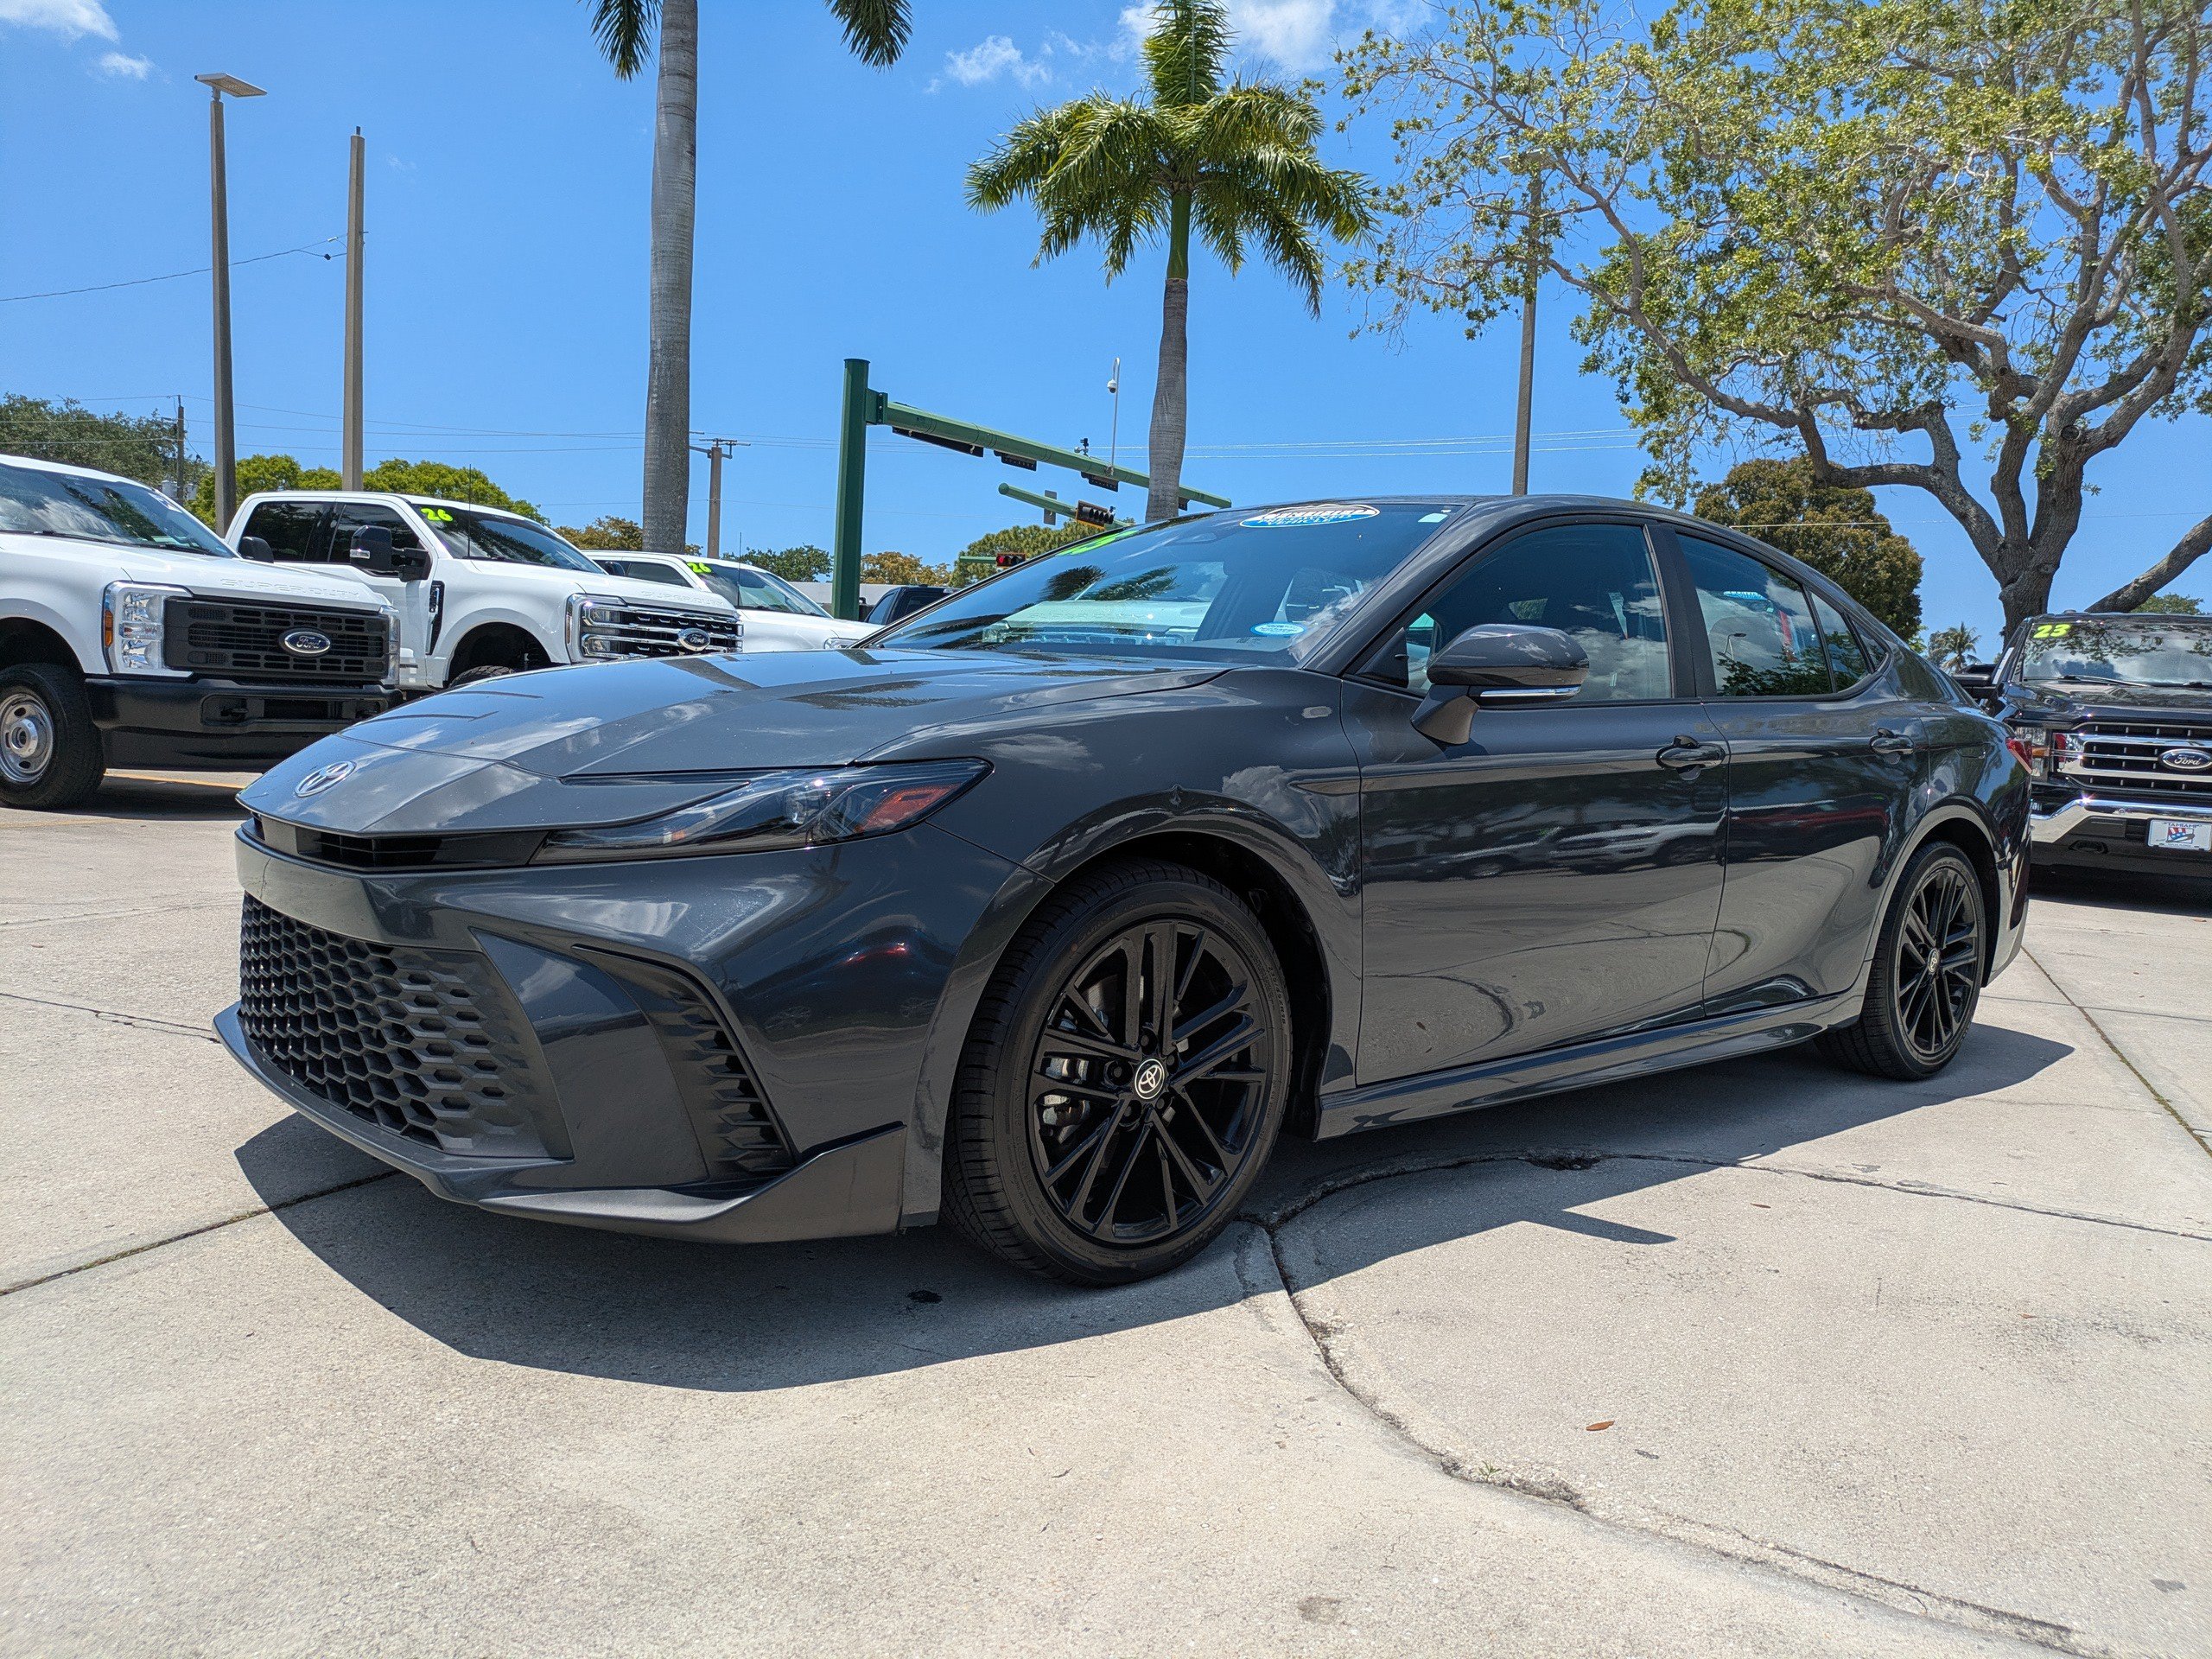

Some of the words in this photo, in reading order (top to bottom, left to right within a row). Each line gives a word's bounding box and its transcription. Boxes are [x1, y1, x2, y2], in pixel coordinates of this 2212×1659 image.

[420, 507, 454, 521] 26
[687, 563, 712, 573] 26
[219, 578, 306, 594] SUPER
[690, 633, 705, 644] Ford
[2034, 624, 2070, 639] 23
[296, 635, 321, 649] Ford
[2173, 753, 2201, 766] Ford
